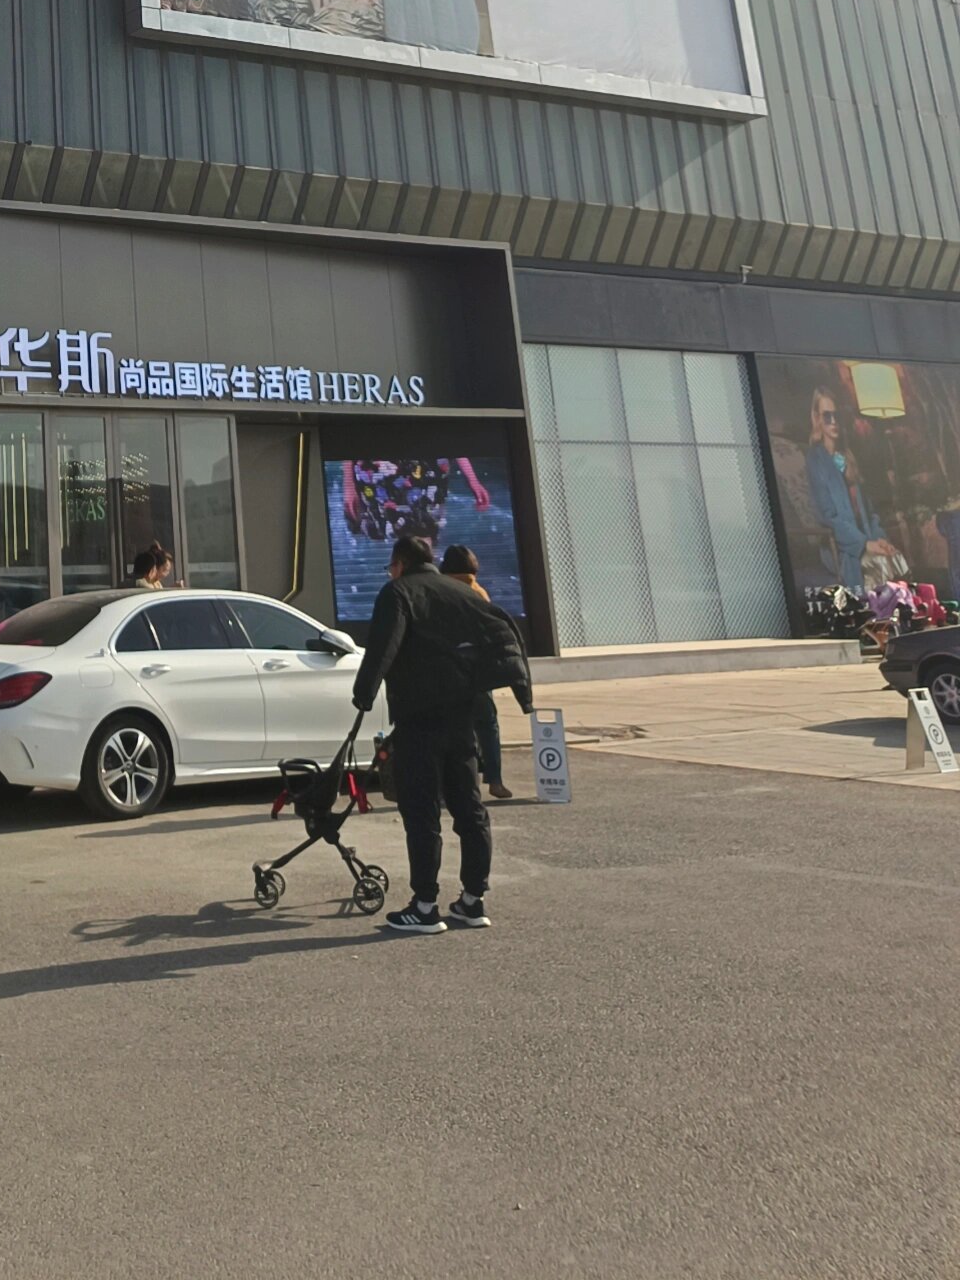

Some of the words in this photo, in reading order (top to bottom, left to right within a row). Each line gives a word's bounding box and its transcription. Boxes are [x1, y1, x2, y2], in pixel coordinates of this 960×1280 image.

[119, 357, 312, 401] 尚品国际生活馆
[316, 371, 426, 407] HERAS
[546, 753, 556, 767] P
